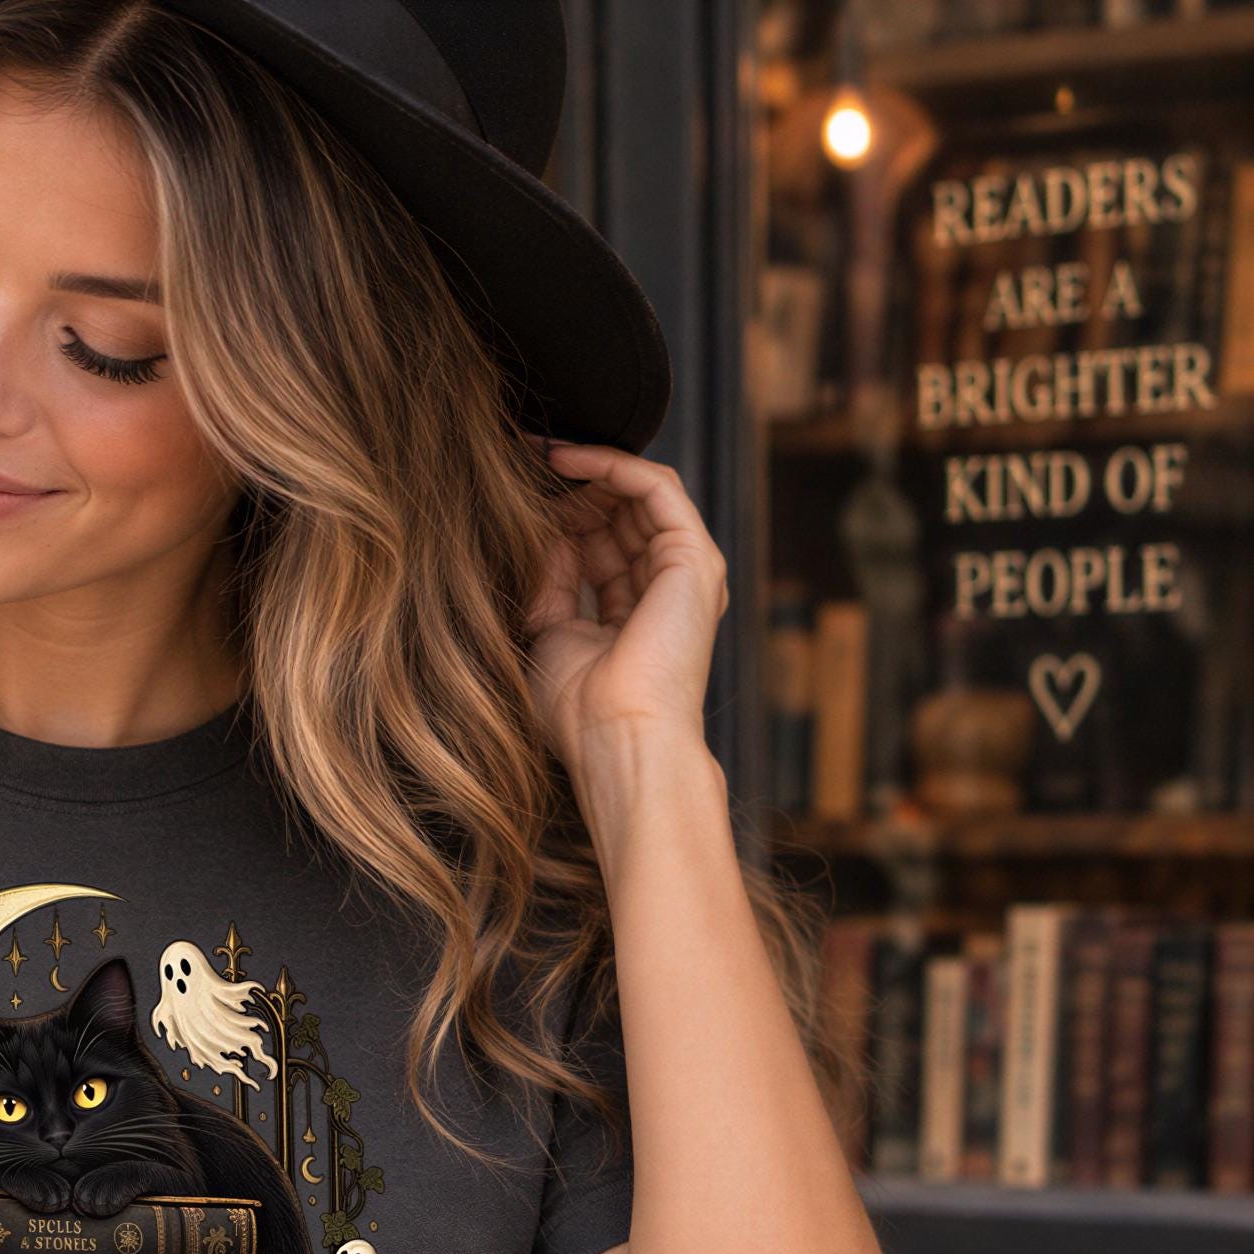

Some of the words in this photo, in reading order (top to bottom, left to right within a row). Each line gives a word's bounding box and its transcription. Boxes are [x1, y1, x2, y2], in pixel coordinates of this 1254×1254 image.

[932, 155, 1199, 247] READERS
[984, 262, 1091, 331] ARE
[1102, 261, 1141, 318] A
[918, 344, 1216, 430] BRIGHTER
[947, 452, 1091, 523] KIND
[1104, 444, 1188, 511] OF
[954, 544, 1182, 618] PEOPLE
